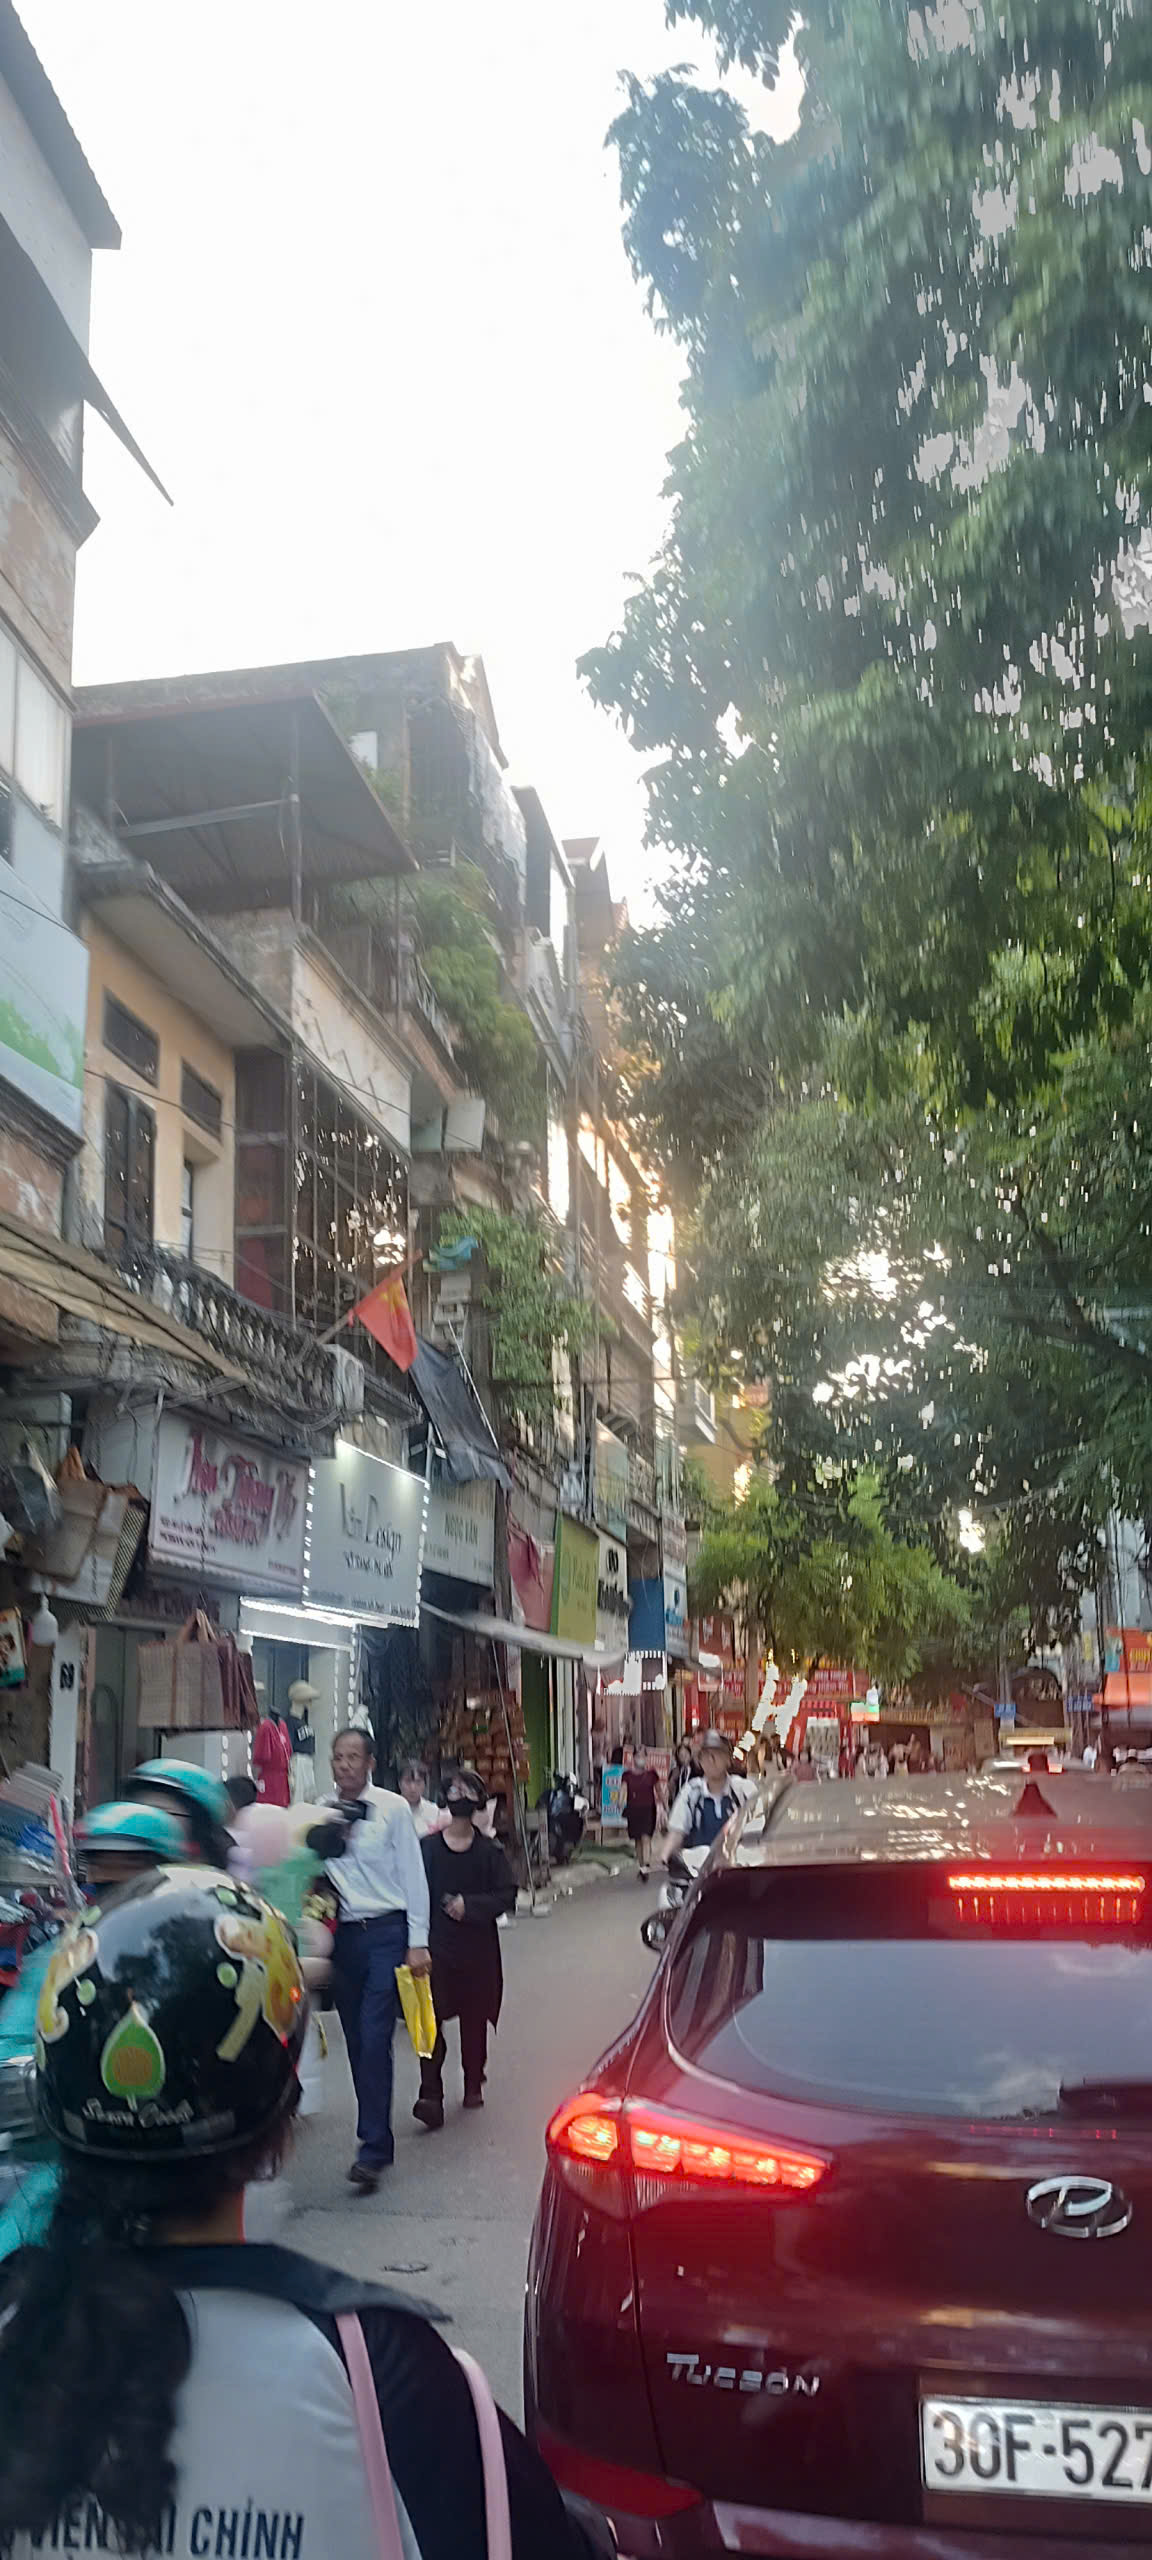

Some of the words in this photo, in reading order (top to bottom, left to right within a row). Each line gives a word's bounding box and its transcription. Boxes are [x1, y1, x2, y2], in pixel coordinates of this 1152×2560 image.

[365, 1492, 402, 1560] Design
[666, 2352, 820, 2397] TUCSON
[933, 2410, 1152, 2488] 30F-527
[190, 2498, 304, 2560] CHÍNH
